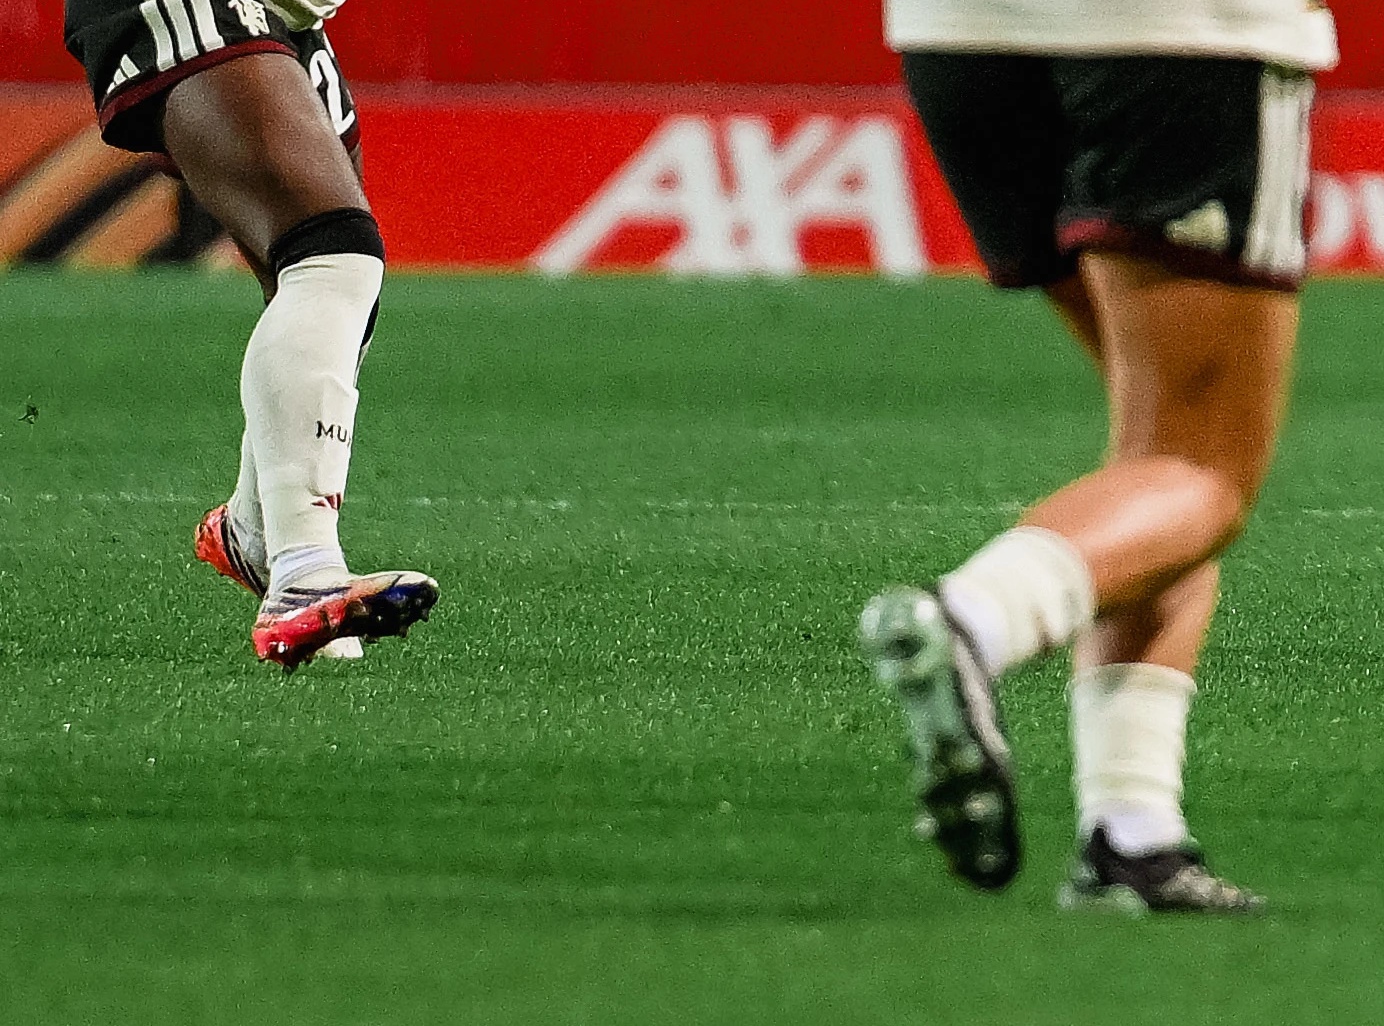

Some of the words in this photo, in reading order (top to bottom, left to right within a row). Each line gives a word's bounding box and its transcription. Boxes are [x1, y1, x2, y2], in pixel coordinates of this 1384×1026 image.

[309, 31, 356, 136] 2
[532, 115, 926, 277] AXA
[316, 420, 352, 448] MU
